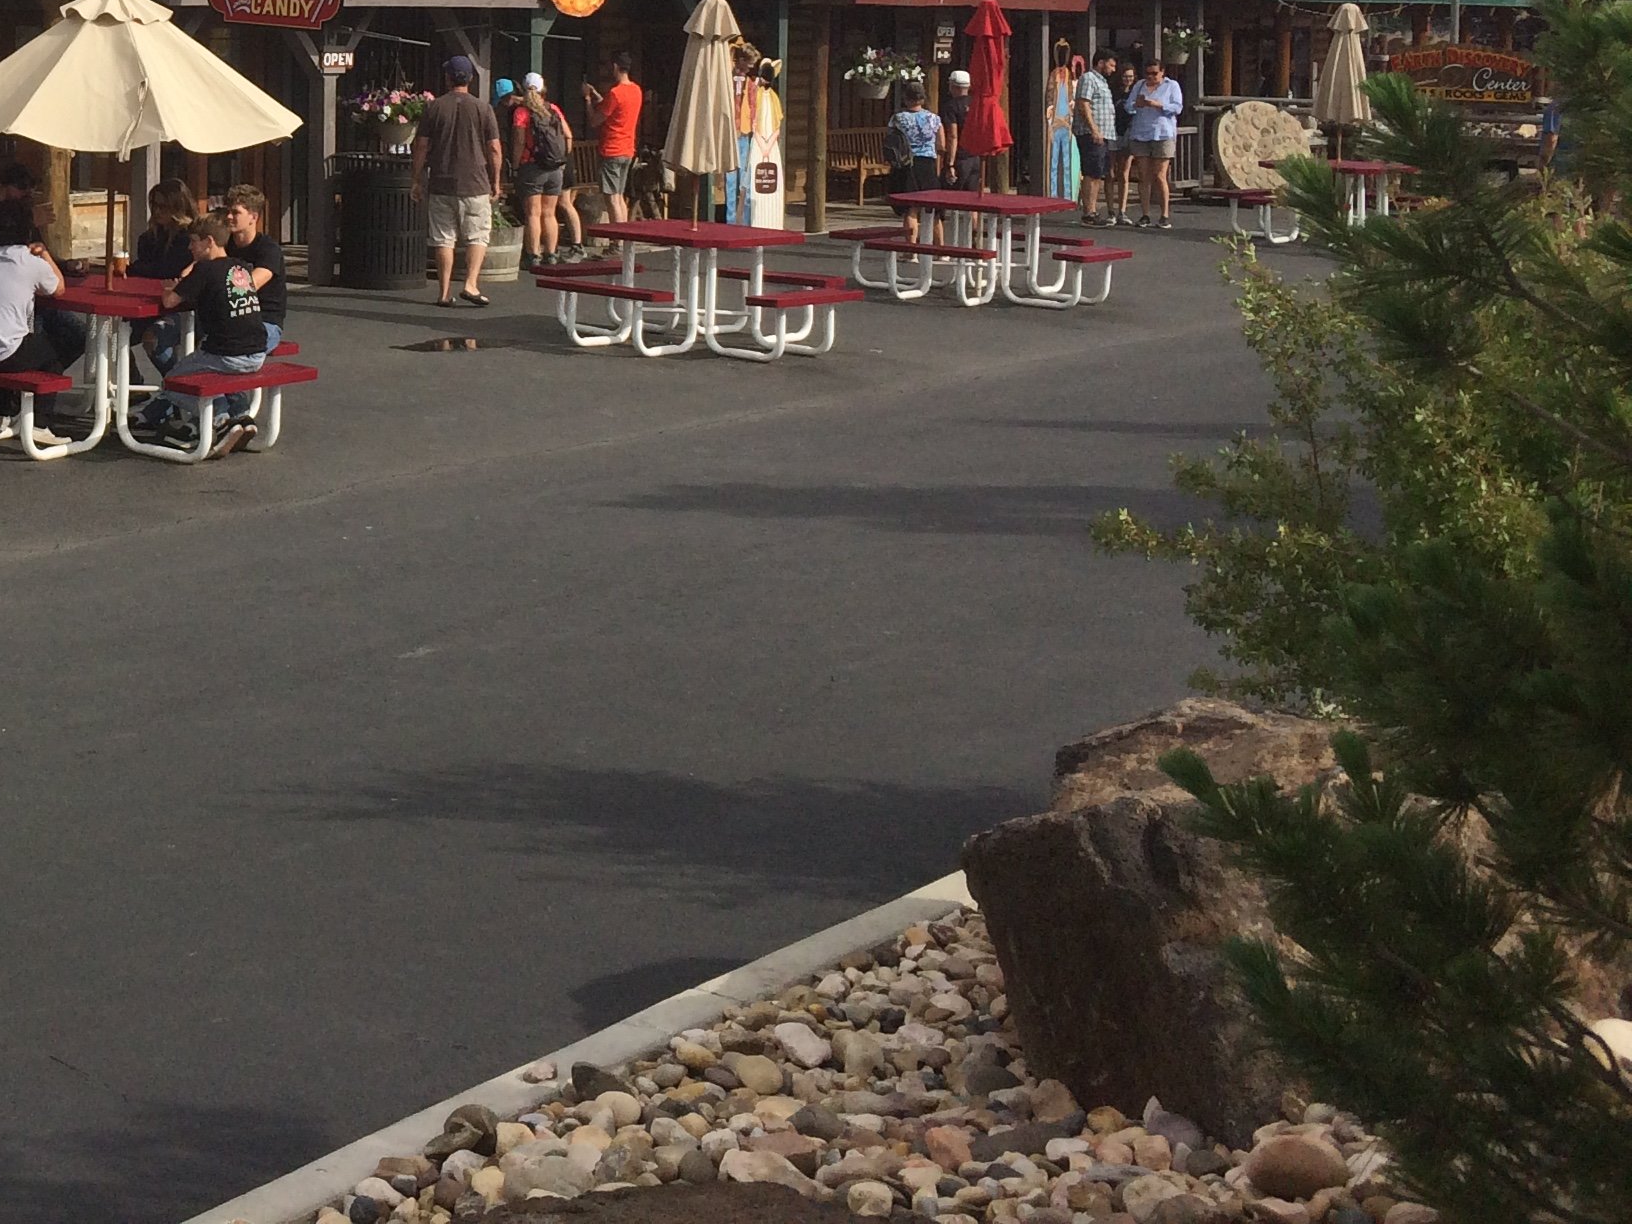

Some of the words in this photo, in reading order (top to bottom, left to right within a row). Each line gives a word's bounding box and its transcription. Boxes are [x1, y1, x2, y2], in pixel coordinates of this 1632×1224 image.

[323, 52, 354, 66] OPEN
[1472, 66, 1531, 92] Center
[1493, 91, 1527, 101] GEMS
